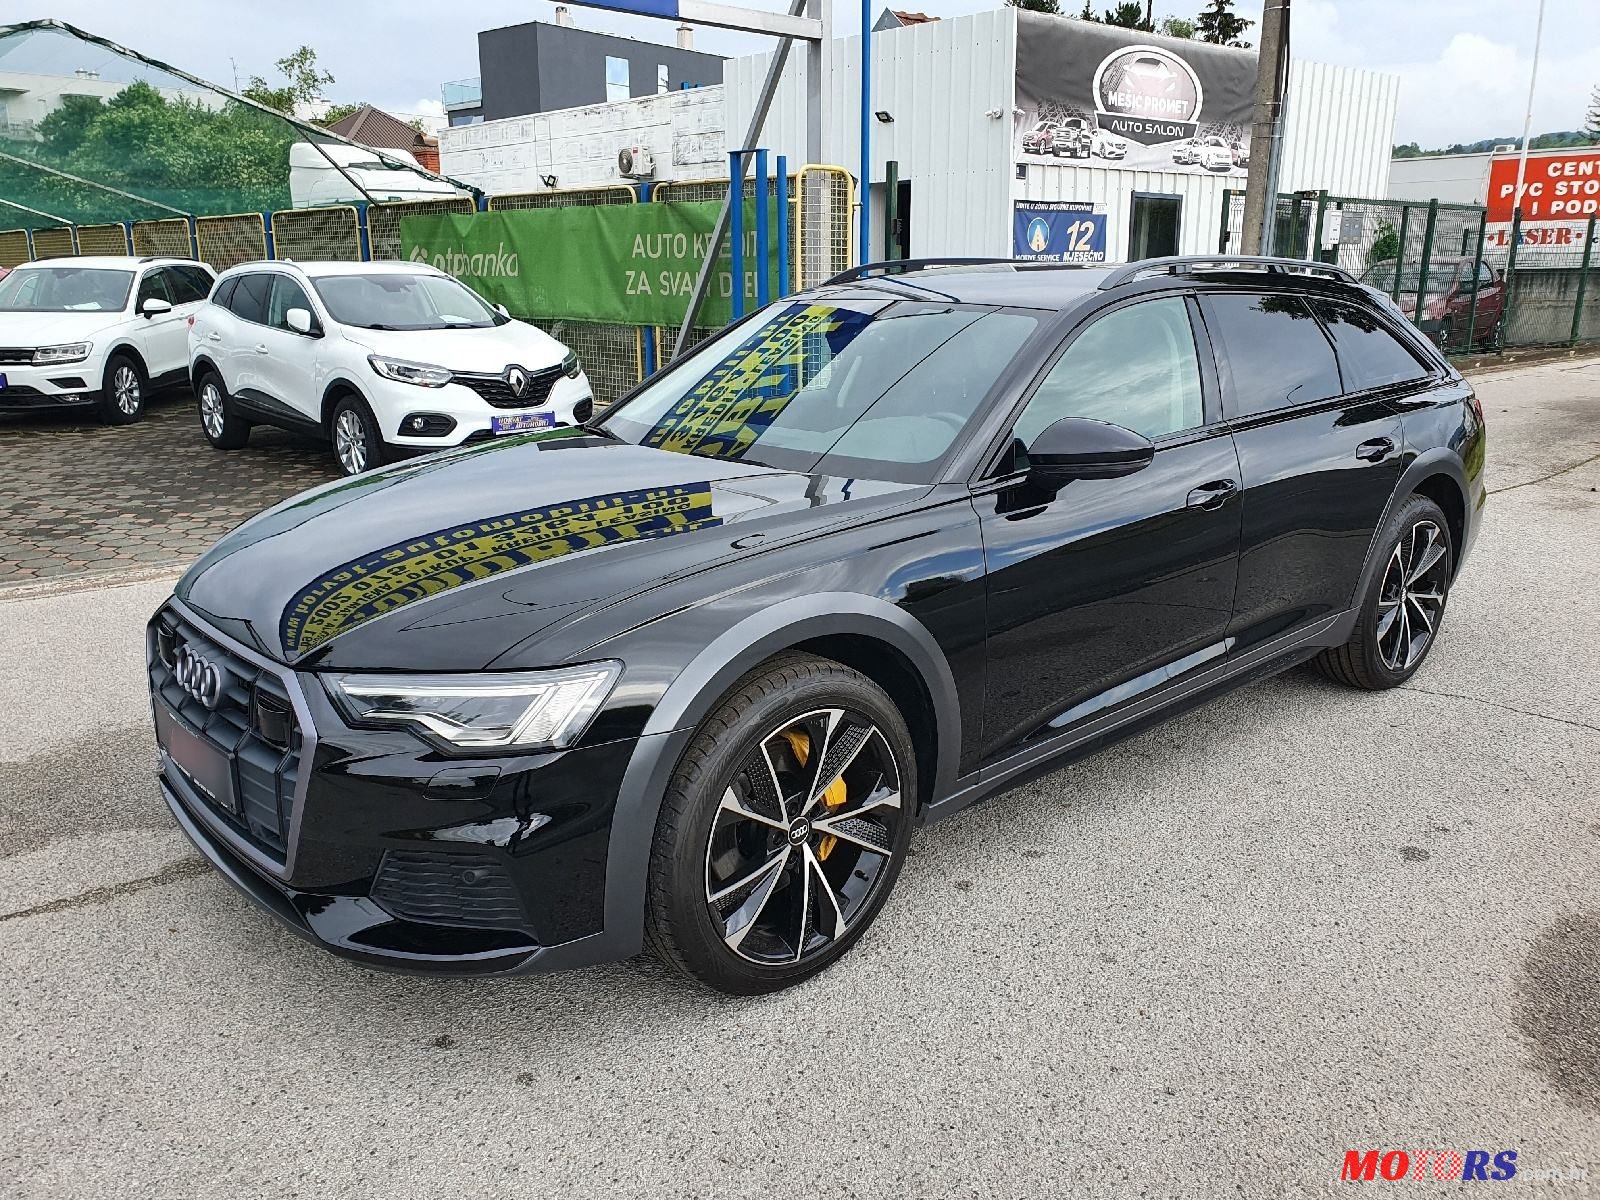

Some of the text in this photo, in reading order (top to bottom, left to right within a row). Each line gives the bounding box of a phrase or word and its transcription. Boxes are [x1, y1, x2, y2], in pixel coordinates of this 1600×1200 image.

[1144, 95, 1189, 113] PROMET
[1111, 120, 1184, 137] AUTO SALON
[1531, 199, 1600, 215] I POD
[632, 231, 758, 259] AUTO KEIT
[1067, 220, 1095, 251] 12
[625, 270, 758, 298] ZA SVAI DE
